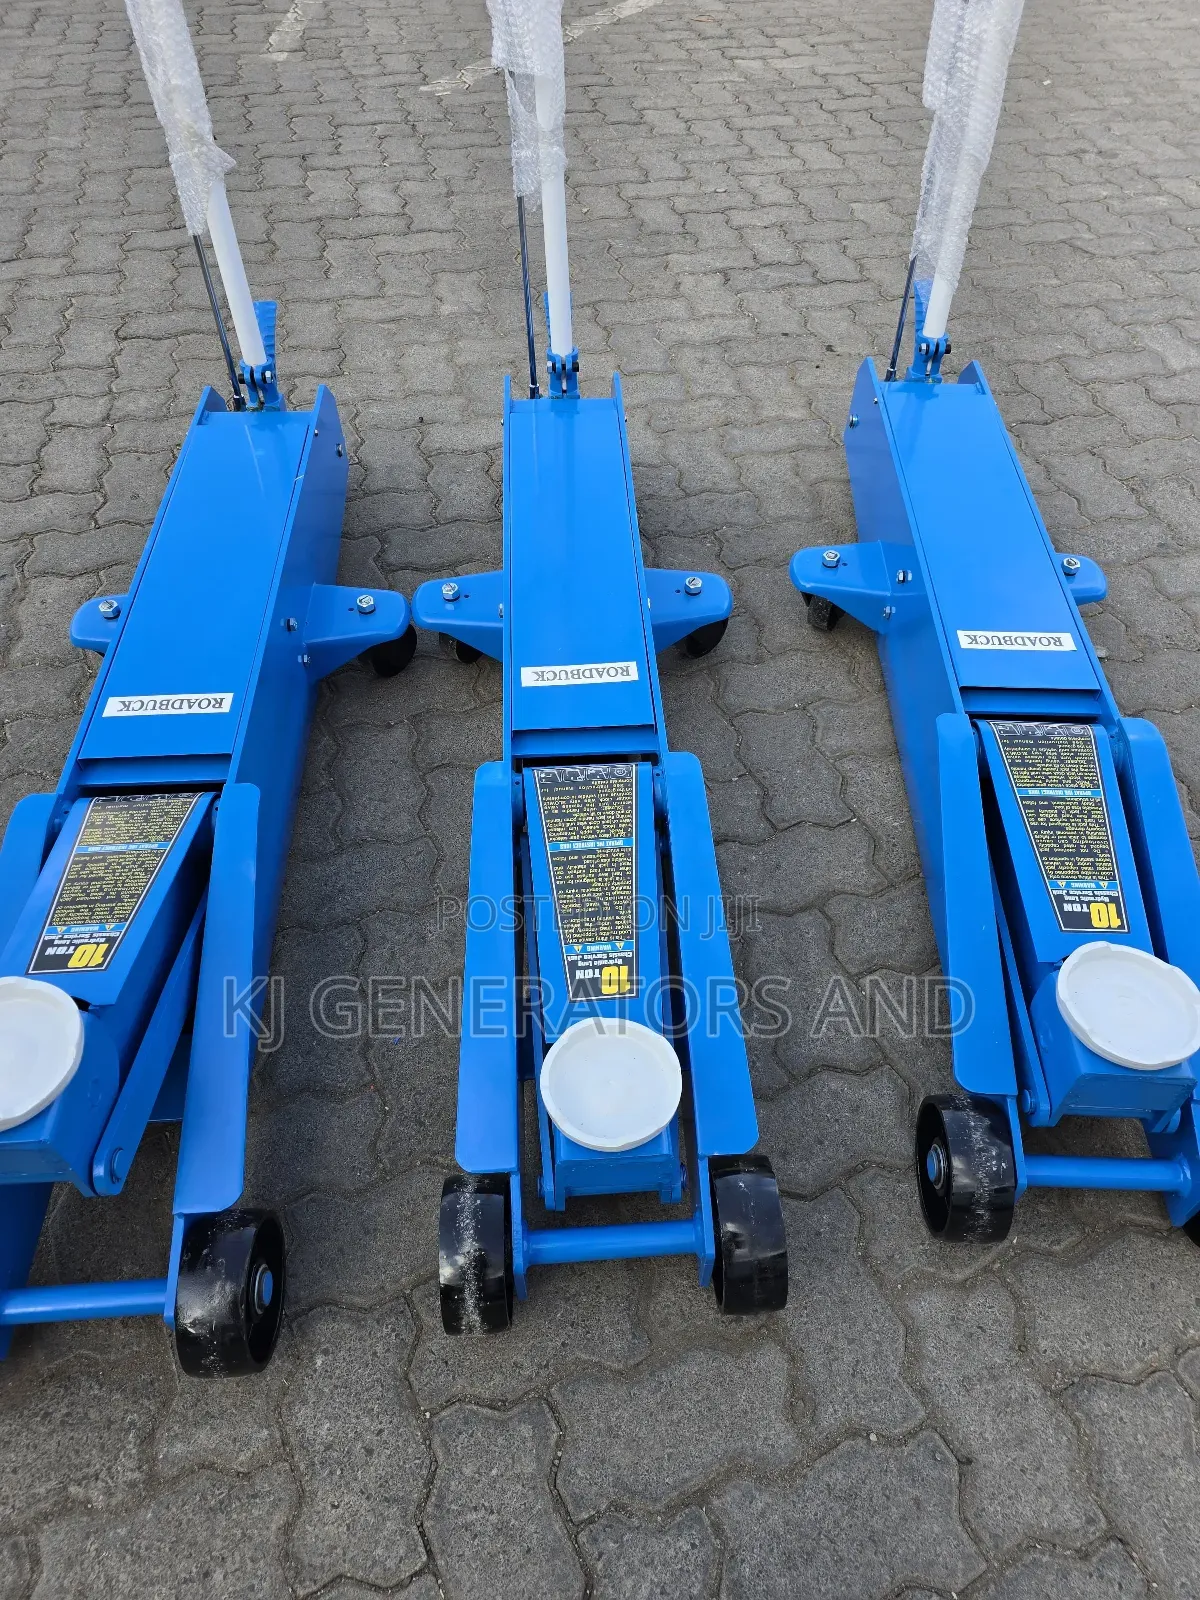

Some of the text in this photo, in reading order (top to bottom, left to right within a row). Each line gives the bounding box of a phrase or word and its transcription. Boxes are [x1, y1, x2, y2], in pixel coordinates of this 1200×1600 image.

[964, 634, 1064, 648] ROADBUCK
[532, 665, 631, 682] ROADBUCK
[117, 697, 225, 712] ROADBUCK
[1063, 903, 1121, 929] 10 TON
[45, 944, 109, 968] 10 TON
[576, 965, 630, 995] 10 TON
